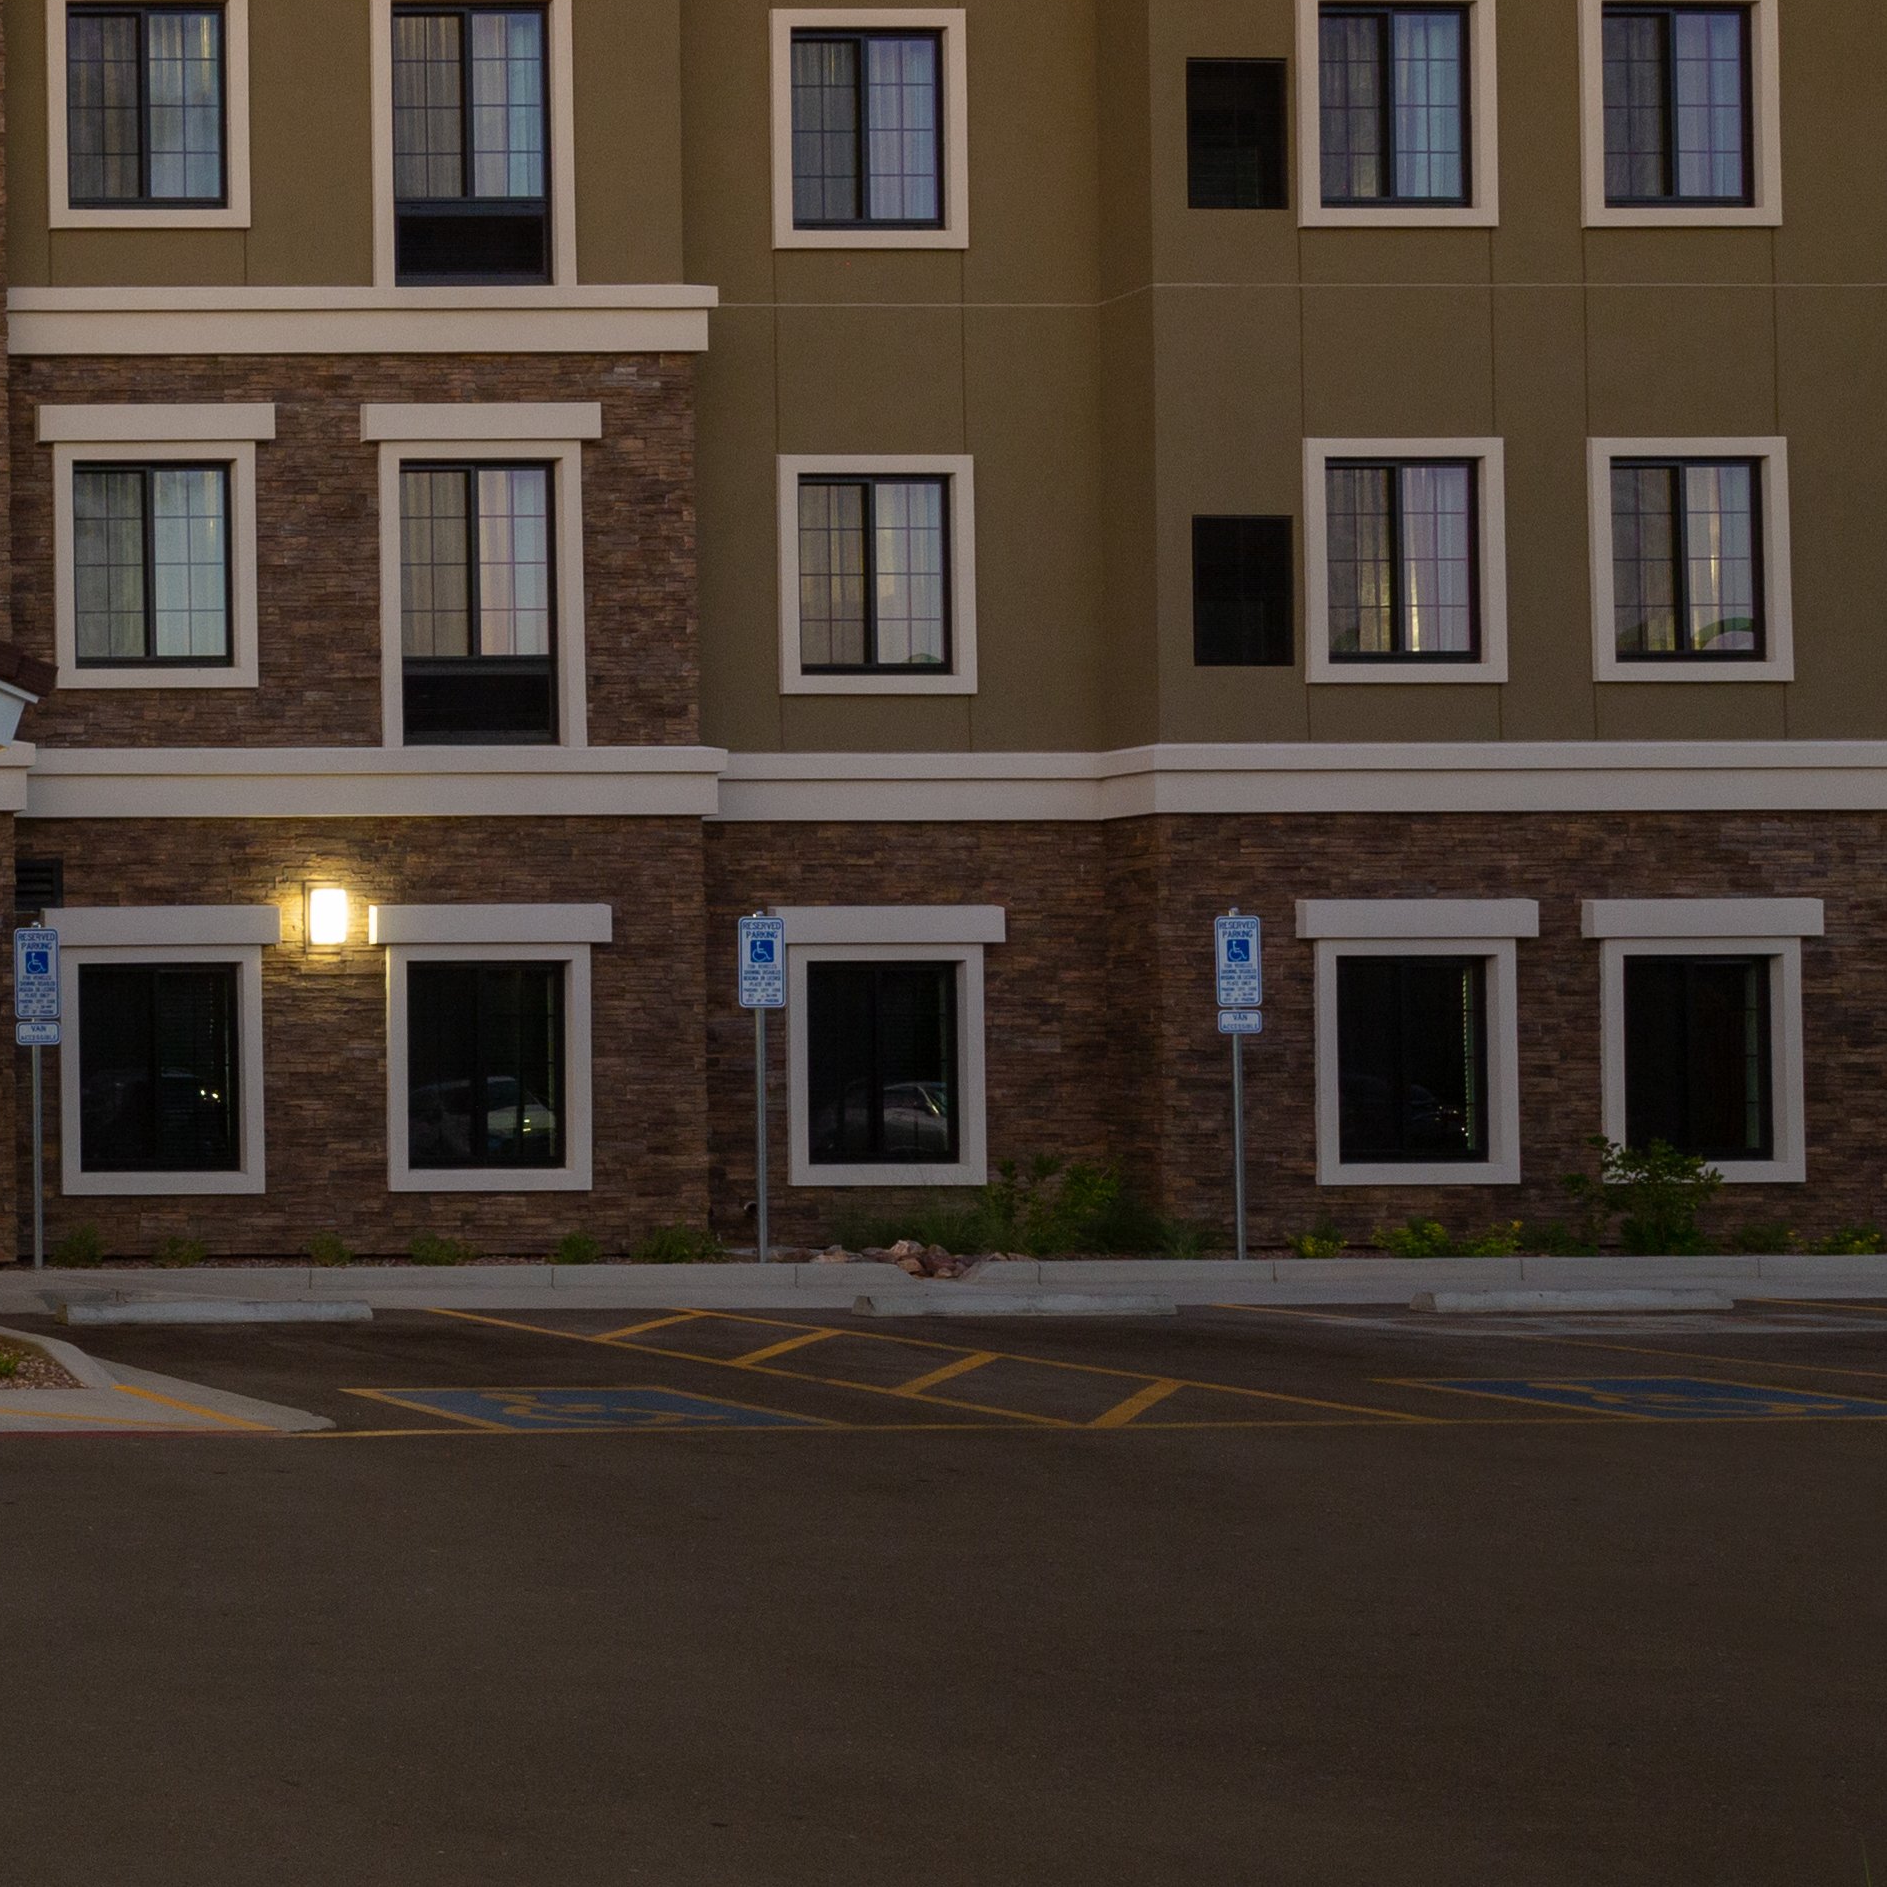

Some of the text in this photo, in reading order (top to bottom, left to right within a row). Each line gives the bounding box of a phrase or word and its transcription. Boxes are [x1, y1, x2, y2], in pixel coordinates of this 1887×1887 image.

[742, 922, 781, 930] RESERVED
[1219, 921, 1256, 929] RESERVED
[18, 933, 56, 941] RESERVED
